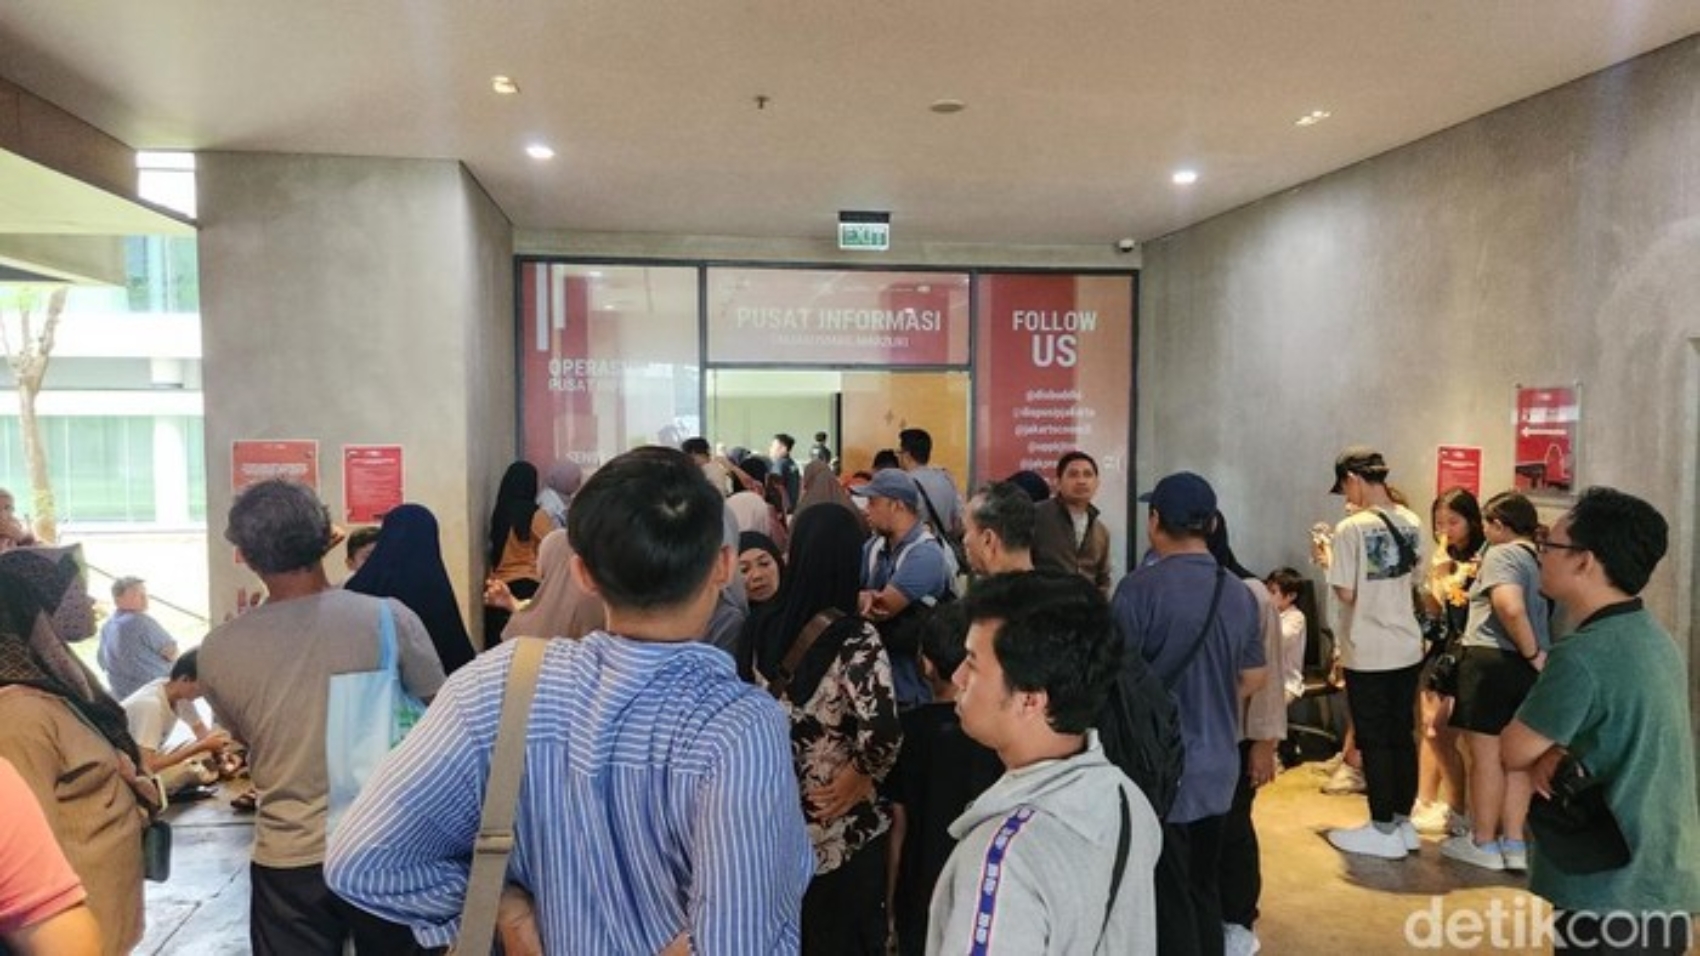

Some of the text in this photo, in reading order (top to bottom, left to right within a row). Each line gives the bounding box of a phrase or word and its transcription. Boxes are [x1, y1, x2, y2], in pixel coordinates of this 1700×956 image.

[843, 225, 887, 245] EXIT
[737, 307, 942, 332] PUSAT INFORMASI
[1012, 310, 1098, 331] FOLLOW
[1032, 334, 1078, 367] US
